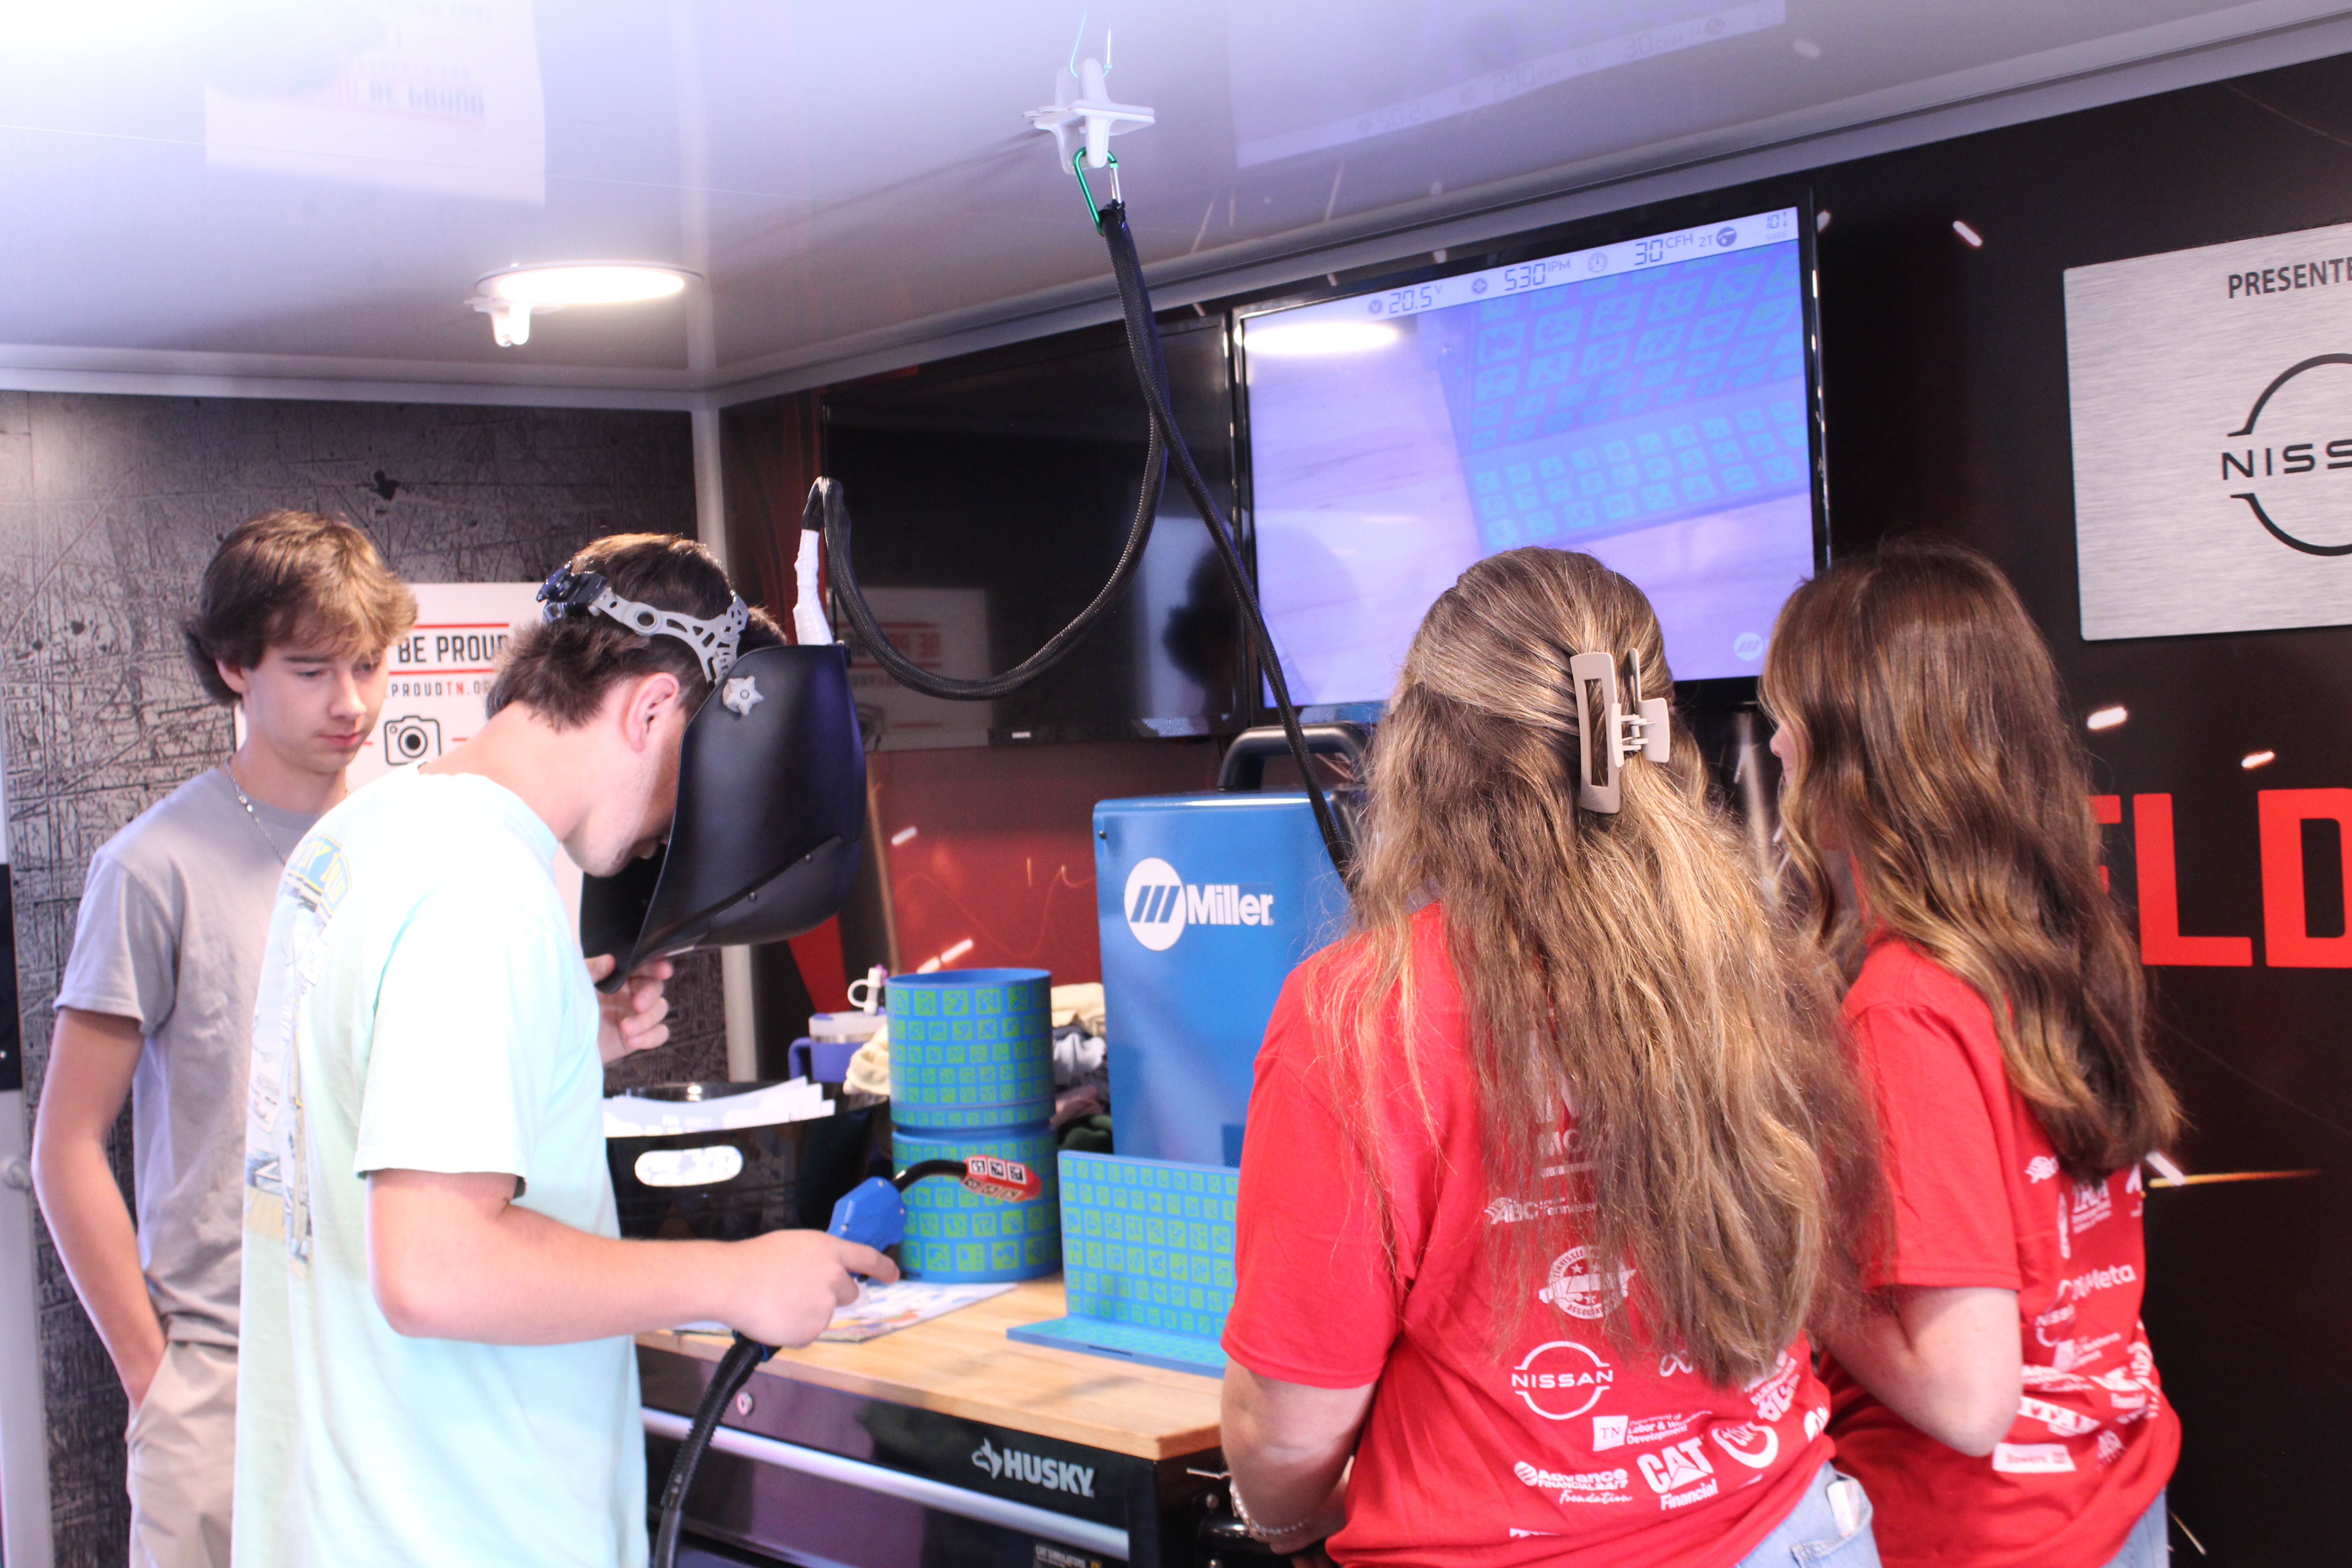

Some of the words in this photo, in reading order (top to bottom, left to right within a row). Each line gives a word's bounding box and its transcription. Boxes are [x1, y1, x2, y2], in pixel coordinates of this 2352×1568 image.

[1389, 286, 1432, 314] 20.5
[1504, 262, 1547, 291] 530
[1547, 258, 1571, 273] IPM
[1634, 239, 1663, 266] 30
[1665, 233, 1694, 249] CFH
[397, 636, 426, 664] BE
[1186, 884, 1274, 926] Miller
[1511, 1369, 1613, 1389] NISSAN
[1599, 1426, 1621, 1440] TN
[1003, 1448, 1095, 1498] HUSKY
[1538, 1468, 1628, 1484] Advance
[1637, 1436, 1714, 1494] CAT
[1660, 1477, 1719, 1510] Financial
